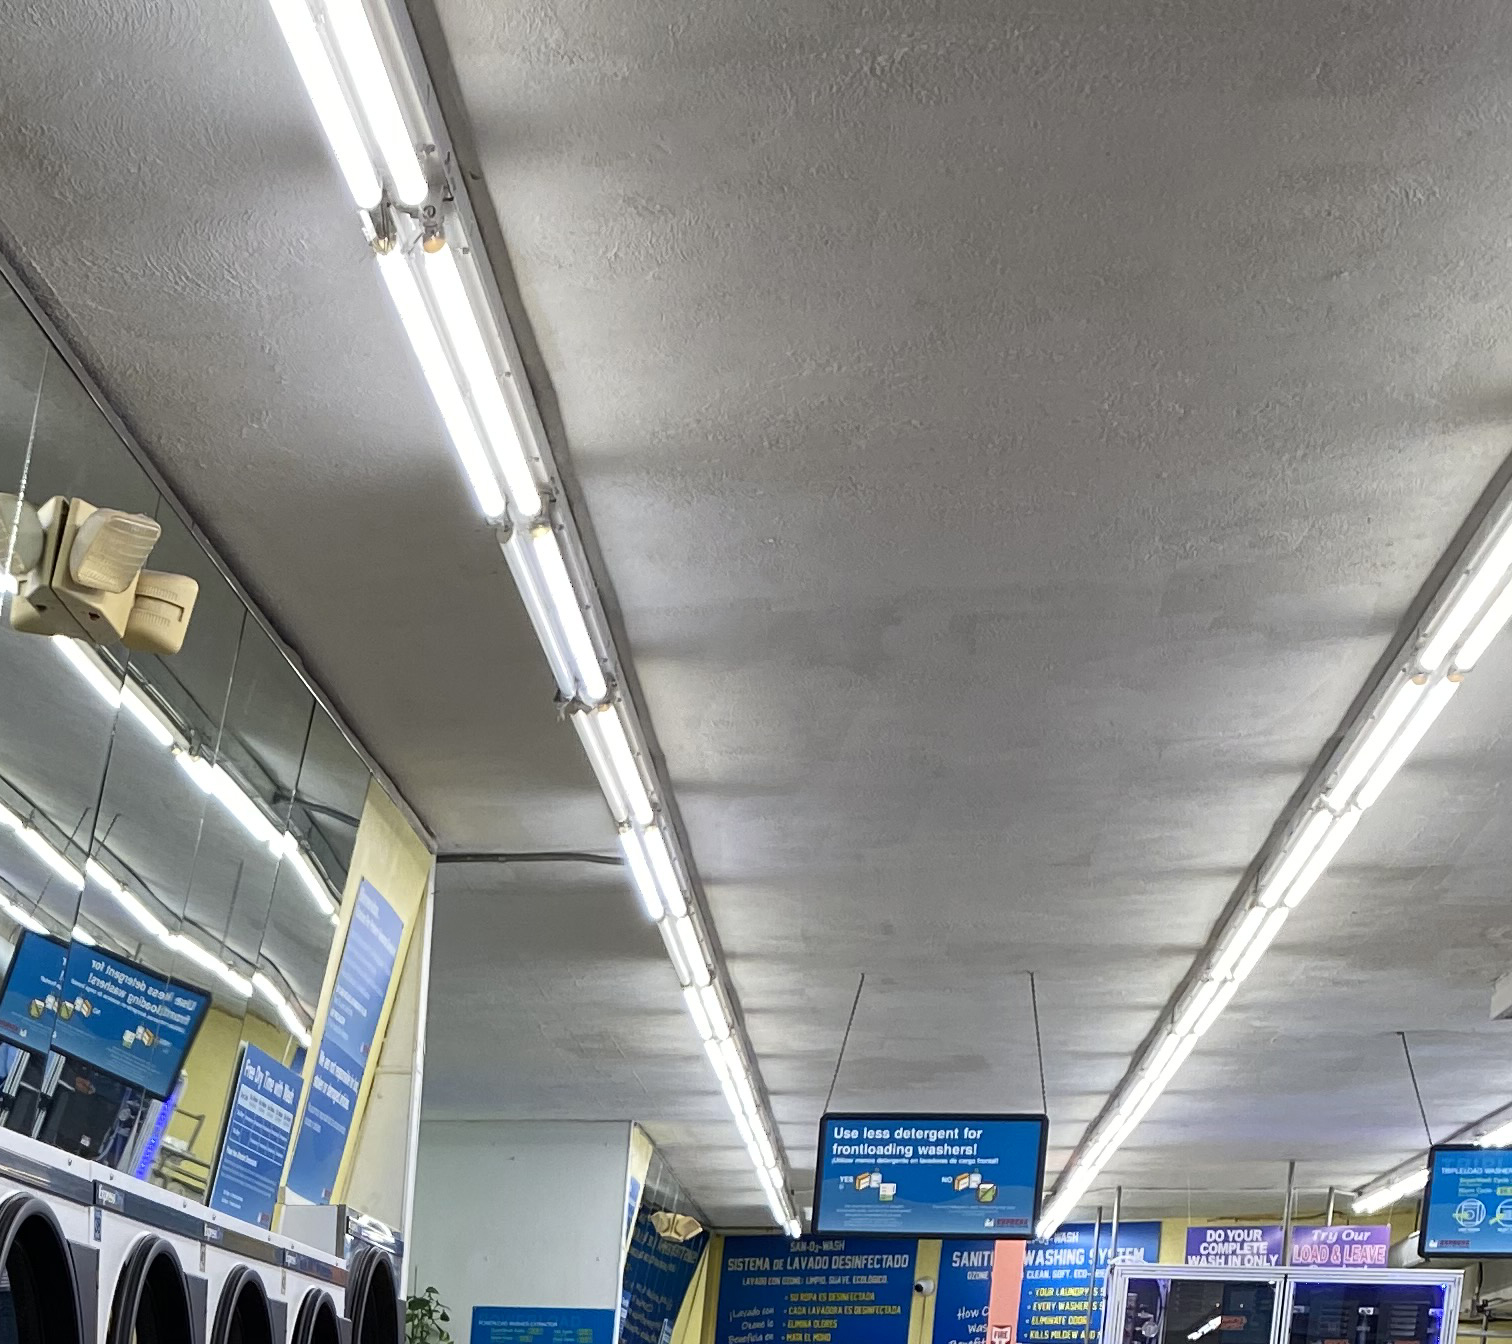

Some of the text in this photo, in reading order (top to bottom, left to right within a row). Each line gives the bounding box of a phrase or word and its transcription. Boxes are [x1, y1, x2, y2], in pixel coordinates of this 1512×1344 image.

[833, 1127, 983, 1141] Use less detergent for
[832, 1143, 977, 1158] frontloading washers!
[941, 1176, 953, 1184] NO
[1206, 1229, 1262, 1242] DO YOUR
[1312, 1229, 1371, 1244] Try Our
[1200, 1242, 1268, 1255] COMPLETE
[1292, 1244, 1387, 1264] LOAD & LEAVE
[727, 1257, 770, 1271] SISTEMA
[787, 1256, 829, 1270] LAVADO
[831, 1254, 909, 1269] DESINFECTADO
[1024, 1248, 1085, 1266] WASHING
[1188, 1254, 1279, 1267] WASH IN ONLY
[966, 1272, 989, 1280] OZONE
[762, 1307, 775, 1315] con
[1032, 1302, 1057, 1311] EVERY
[956, 1307, 979, 1320] How
[994, 1330, 1009, 1339] FIRE
[1029, 1330, 1078, 1339] KILLS MILDEW
